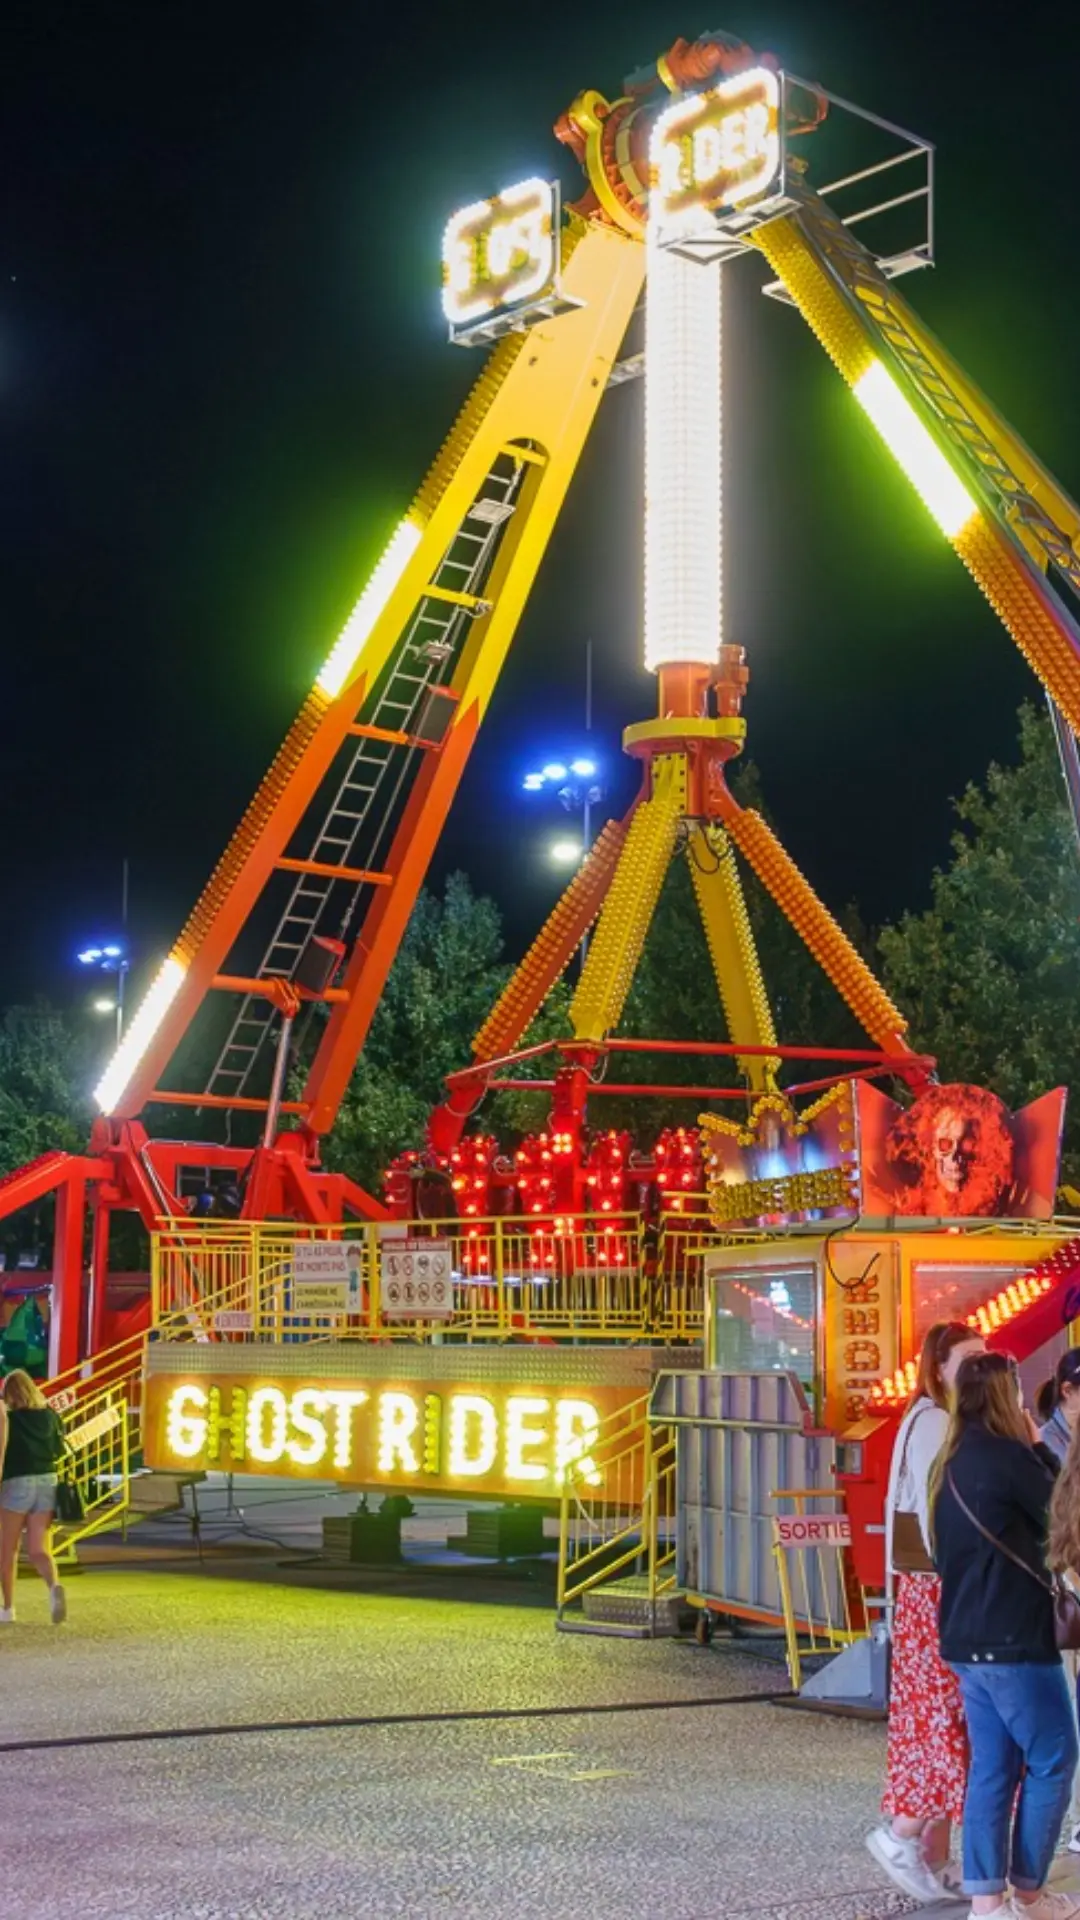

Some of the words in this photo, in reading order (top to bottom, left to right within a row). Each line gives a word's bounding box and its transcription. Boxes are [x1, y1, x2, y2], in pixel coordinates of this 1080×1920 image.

[167, 1384, 368, 1469] GHOST
[378, 1390, 603, 1485] RIDER
[779, 1521, 851, 1540] SORTIE
